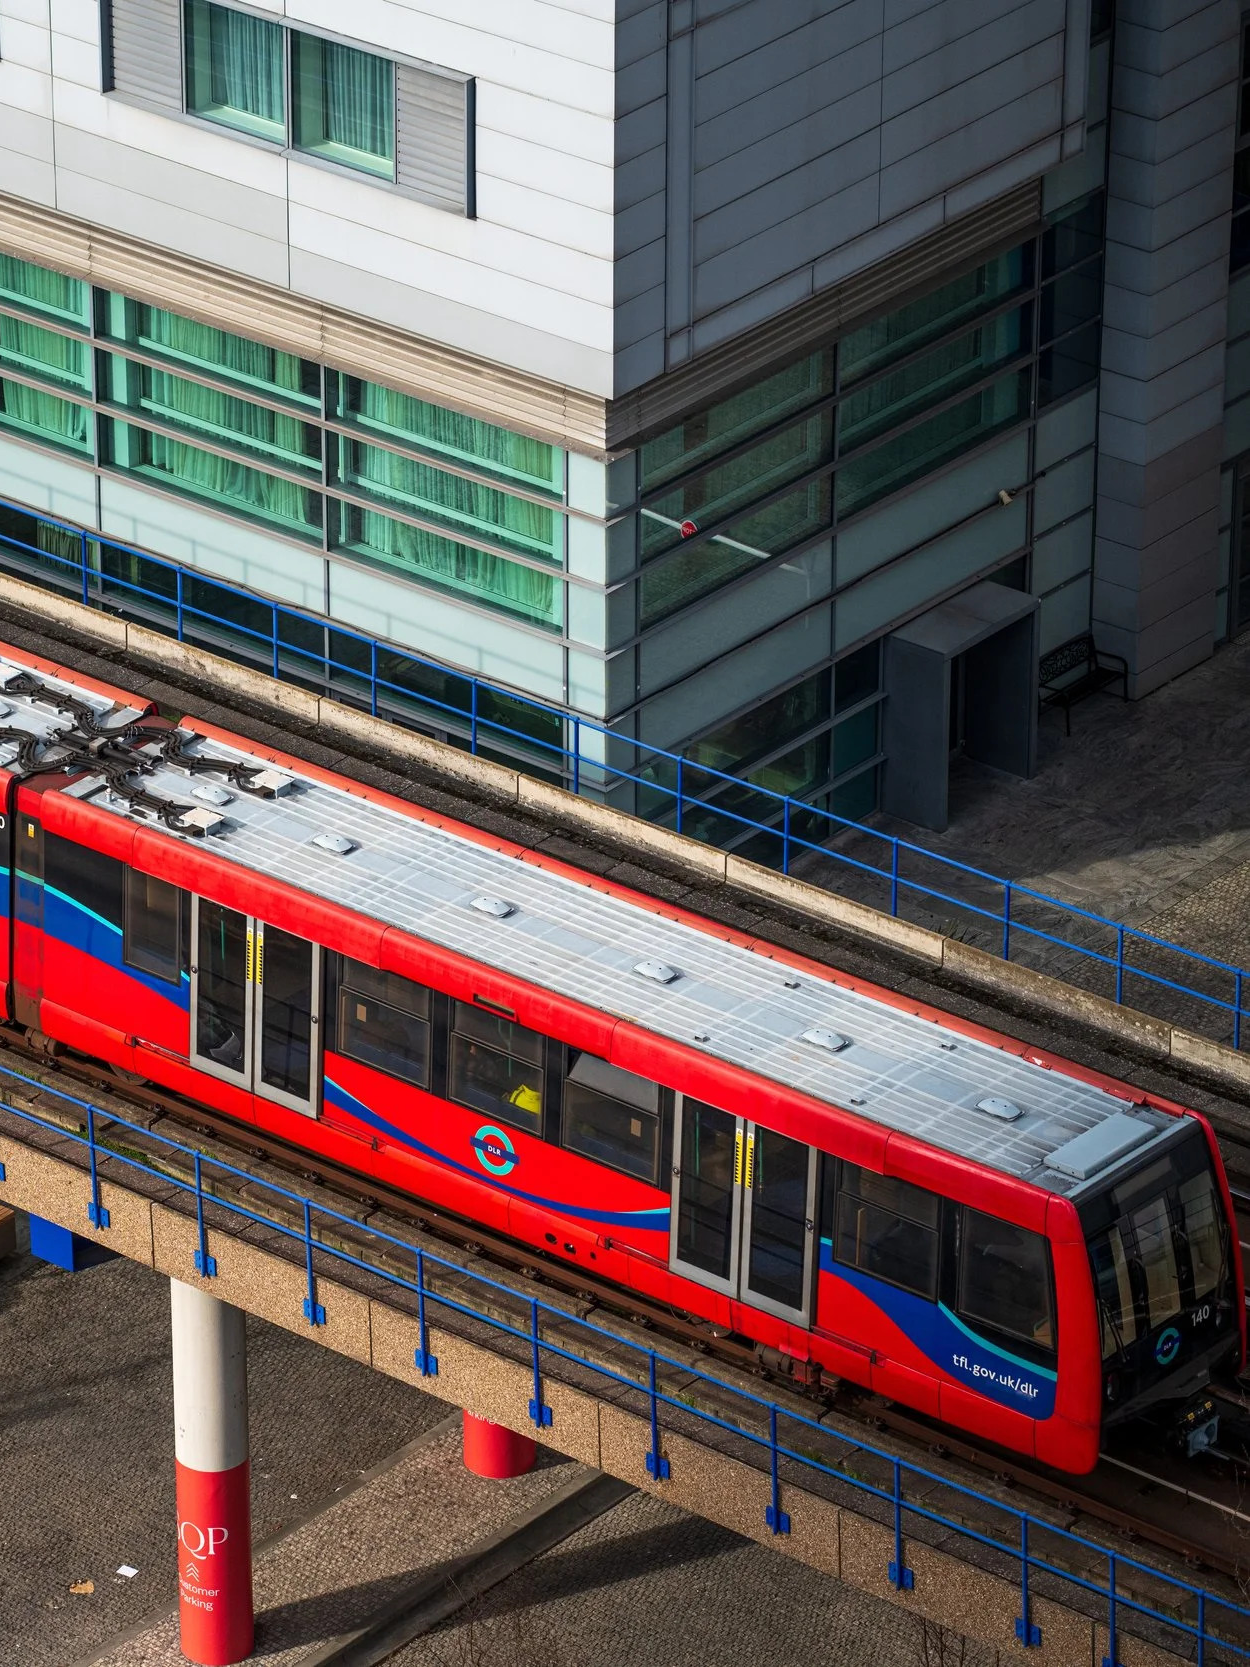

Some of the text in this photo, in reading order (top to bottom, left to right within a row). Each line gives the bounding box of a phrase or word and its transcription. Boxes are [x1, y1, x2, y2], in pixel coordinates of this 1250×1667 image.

[487, 1145, 501, 1156] DLR
[1191, 1304, 1210, 1327] 140
[952, 1353, 1039, 1398] tfl.gov.uk/dlr
[176, 1509, 229, 1561] QP
[180, 1587, 214, 1612] Parking
